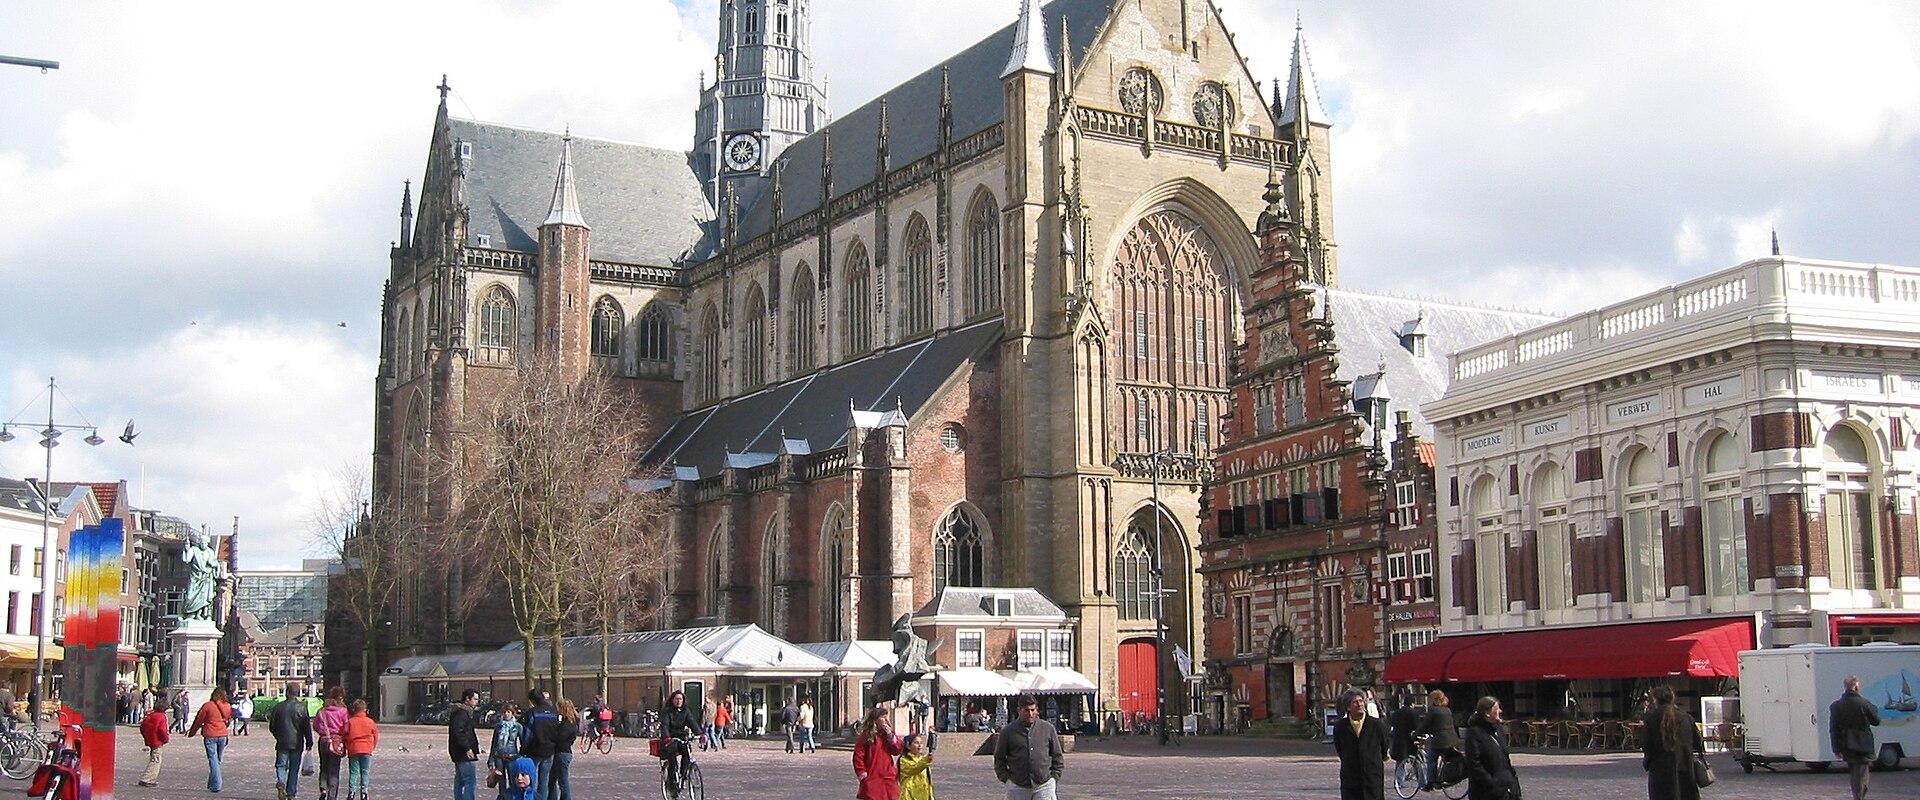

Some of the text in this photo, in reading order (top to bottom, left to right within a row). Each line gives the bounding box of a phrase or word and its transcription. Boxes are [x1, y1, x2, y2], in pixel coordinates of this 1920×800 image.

[1467, 385, 1722, 450] MODERNE KUNST VERWEY HAL
